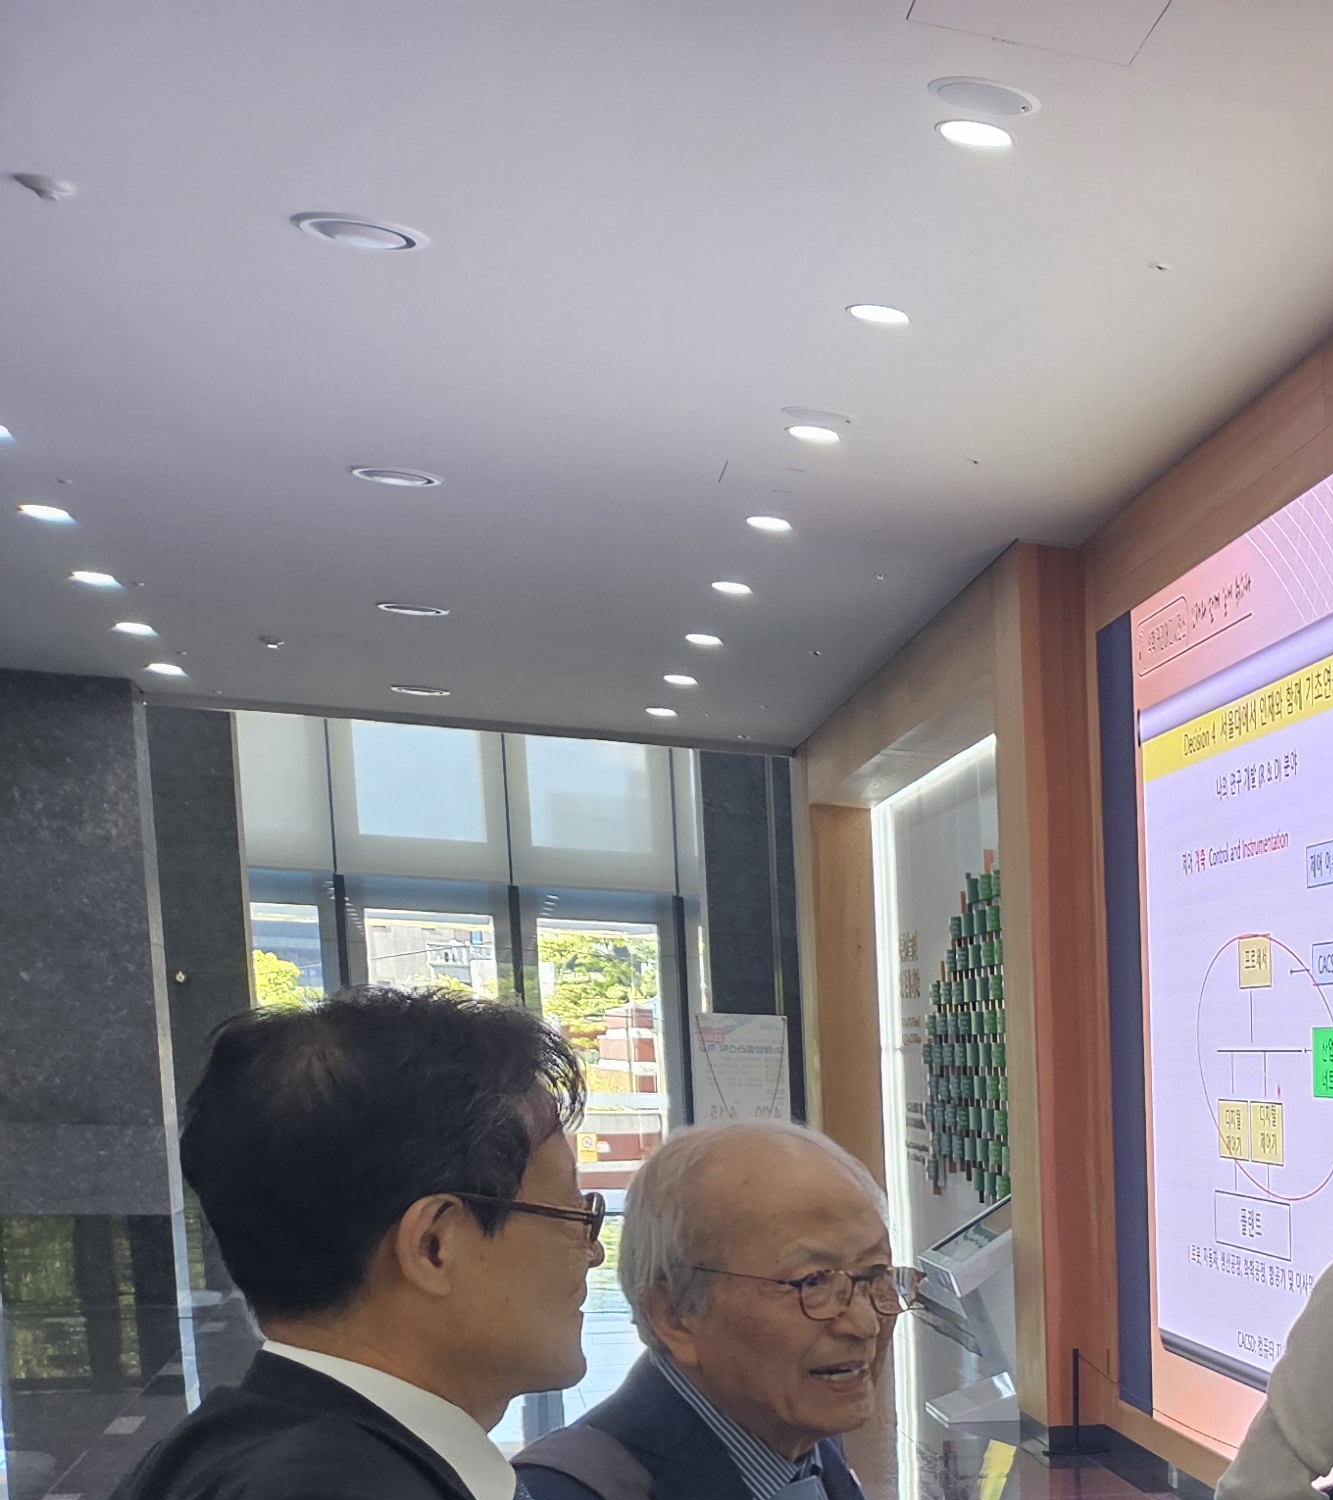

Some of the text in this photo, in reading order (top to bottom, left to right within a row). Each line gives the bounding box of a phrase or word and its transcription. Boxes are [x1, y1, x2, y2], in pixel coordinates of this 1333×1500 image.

[1184, 727, 1209, 755] Decision
[1220, 698, 1256, 741] 서울대에서
[1286, 679, 1302, 714] 함께
[1243, 763, 1256, 790] 개발
[1283, 749, 1297, 776] 분야
[1208, 829, 1289, 867] Control and Instrumentation
